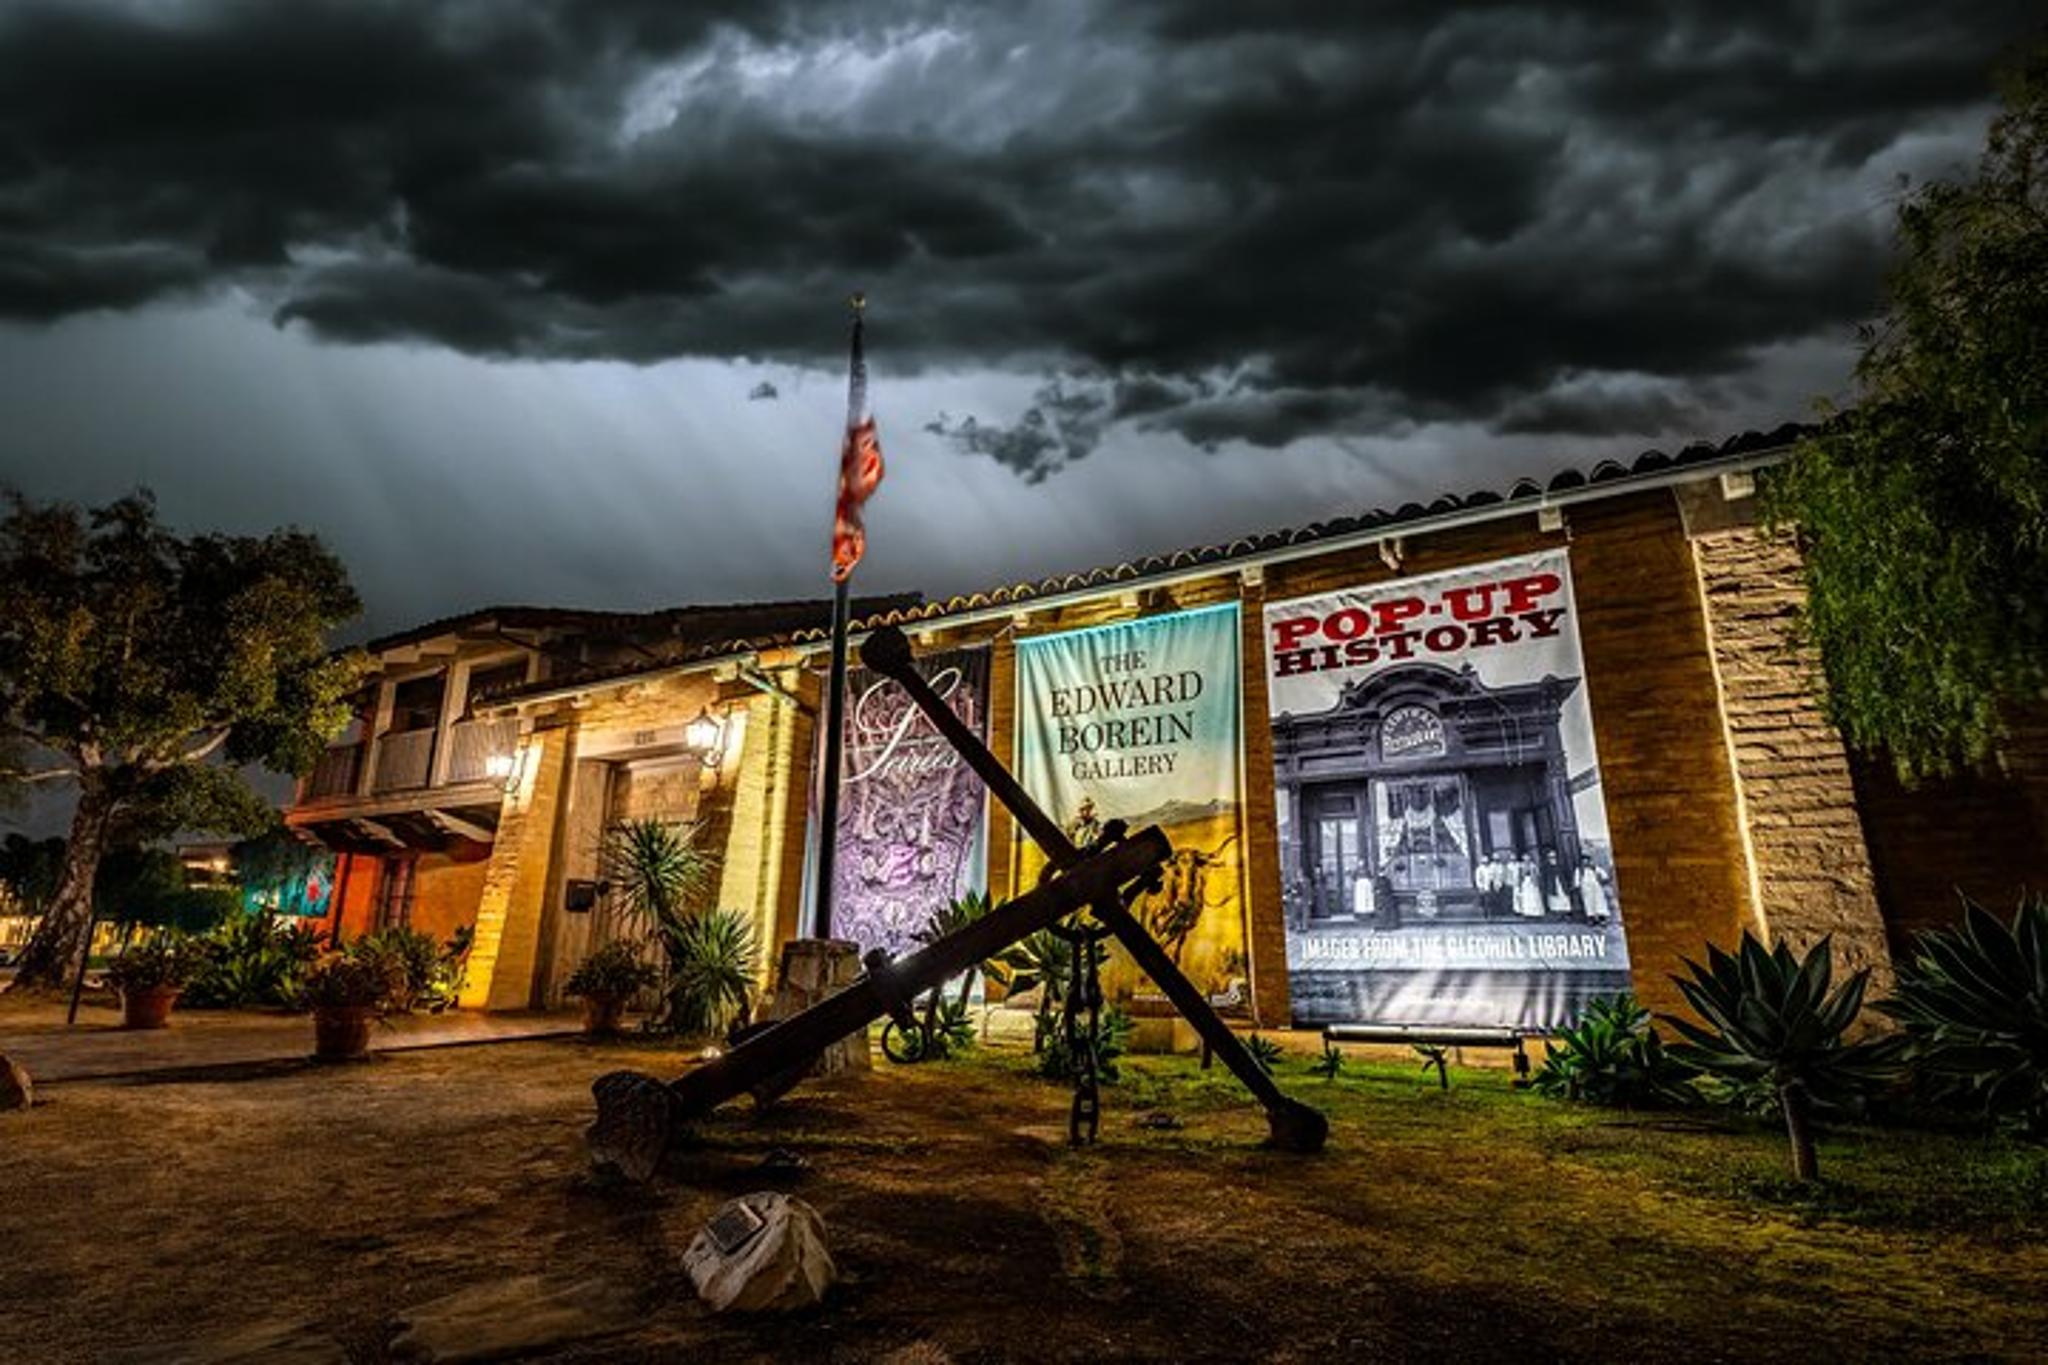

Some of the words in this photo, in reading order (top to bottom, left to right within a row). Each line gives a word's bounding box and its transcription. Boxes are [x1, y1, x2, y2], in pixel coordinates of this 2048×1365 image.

[1271, 574, 1561, 651] POP-UP
[1102, 651, 1146, 674] THE
[1274, 608, 1566, 678] HISTORY
[1051, 670, 1203, 717] EDWARD
[1060, 711, 1195, 755] BOREIN
[1072, 751, 1178, 781] GALLERY
[1301, 937, 1359, 960] IMAGES
[1362, 936, 1406, 959] FROM
[1411, 936, 1442, 959] THE
[1528, 934, 1606, 958] LIBRARY
